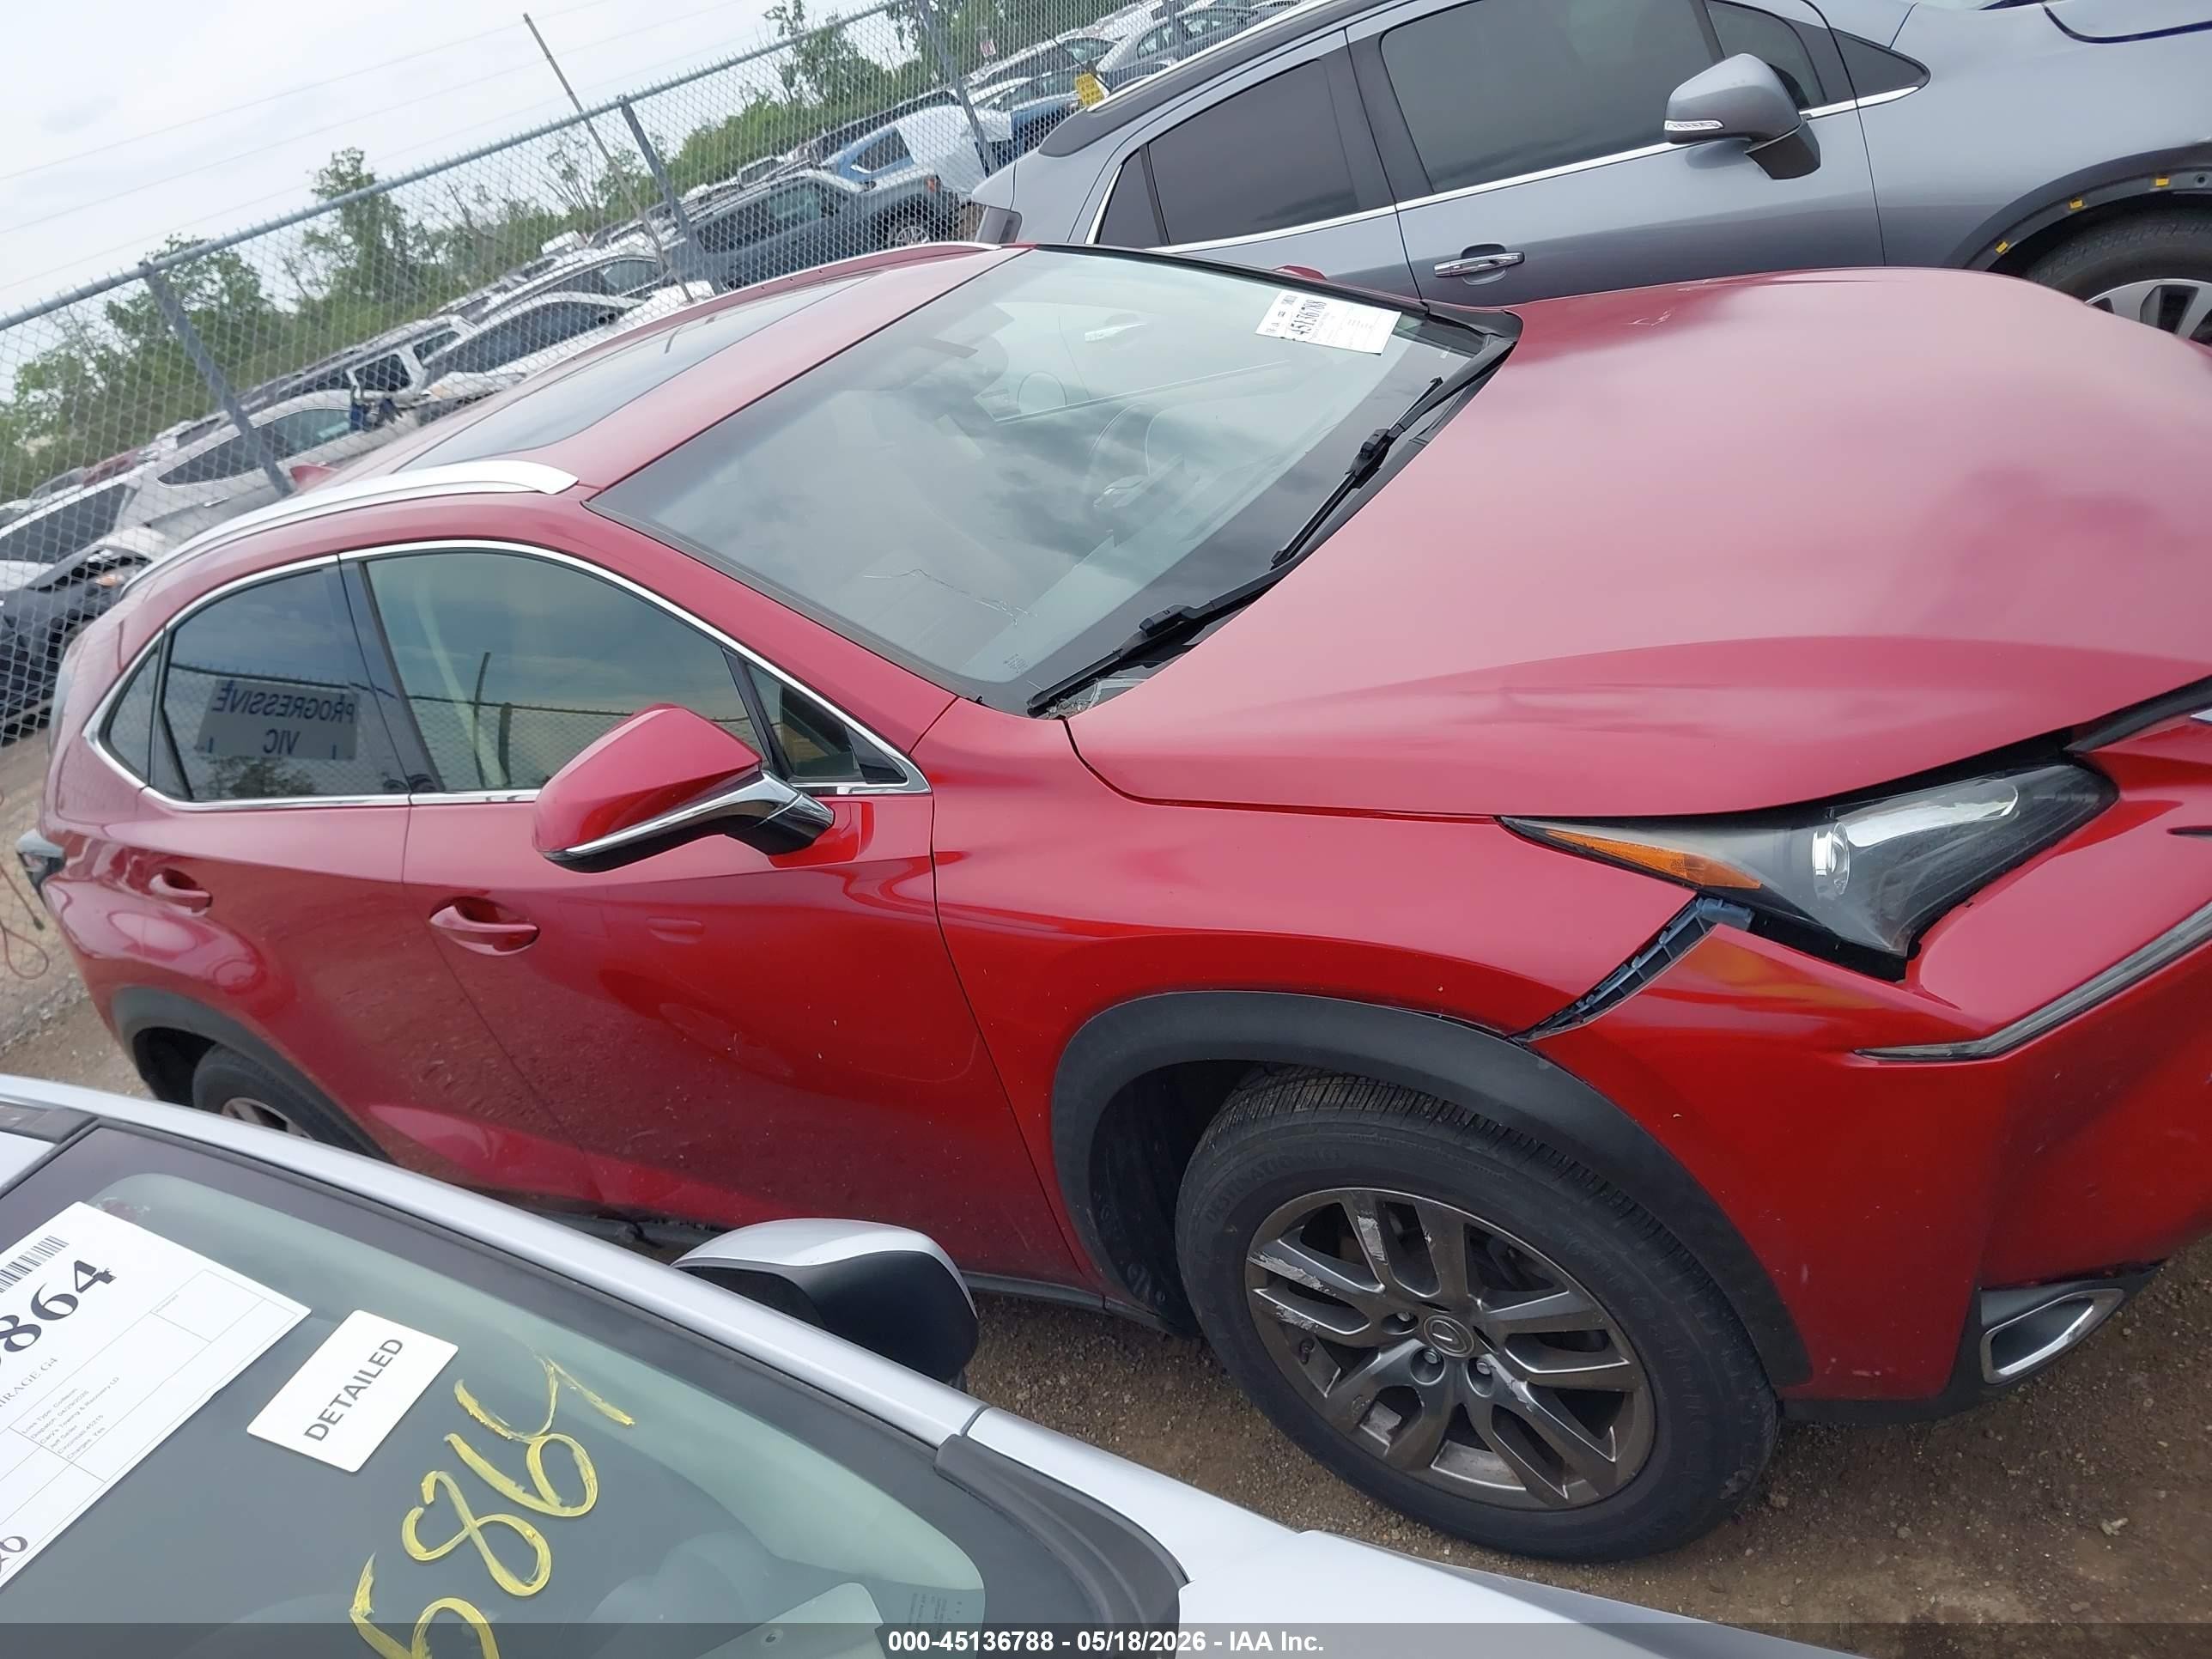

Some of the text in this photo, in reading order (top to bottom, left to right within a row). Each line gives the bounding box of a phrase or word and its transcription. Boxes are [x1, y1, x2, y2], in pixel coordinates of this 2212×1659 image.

[1291, 299, 1328, 336] 45136788
[0, 1260, 118, 1353] 864
[0, 1370, 41, 1407] IRAGE
[304, 1338, 404, 1442] DETAILED
